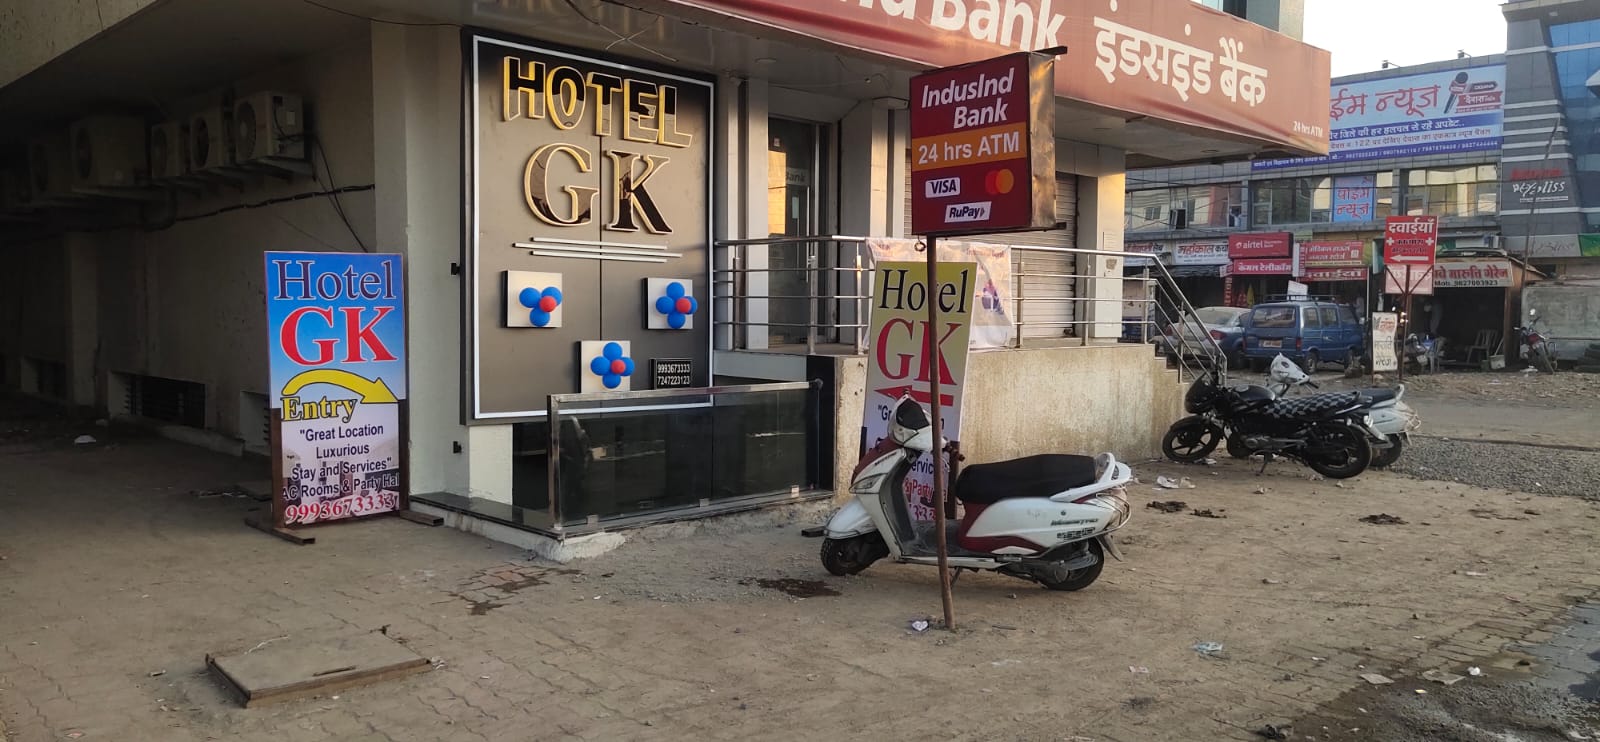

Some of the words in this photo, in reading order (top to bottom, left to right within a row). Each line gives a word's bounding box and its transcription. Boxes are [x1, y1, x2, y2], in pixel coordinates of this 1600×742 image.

[1094, 0, 1214, 102] इंडसइंड
[1219, 36, 1268, 108] बैंक
[922, 67, 1015, 108] IndusInd
[503, 56, 693, 148] HOTEL
[954, 98, 1008, 129] Bank
[1330, 88, 1368, 121] ईम
[1375, 84, 1442, 118] न्यूज
[1293, 121, 1301, 133] 24
[1302, 124, 1310, 135] hrs
[1311, 126, 1323, 138] ATM
[1371, 128, 1382, 137] हर
[1411, 122, 1420, 131] से
[918, 143, 938, 165] 24
[944, 141, 972, 161] hrs
[977, 131, 1019, 157] ATM
[524, 142, 672, 234] GK
[931, 179, 957, 195] VISA
[949, 206, 980, 219] RuPay
[1335, 202, 1369, 219] न्यूज
[1242, 239, 1263, 248] airtel
[273, 259, 396, 301] Hotel
[878, 268, 969, 313] Hoel
[280, 306, 398, 366] GK
[876, 317, 962, 387] GK
[657, 364, 691, 373] 9993673333
[657, 375, 690, 385] 7247223123
[281, 396, 357, 424] Entry
[299, 427, 336, 442] "Great
[338, 425, 384, 441] Location
[316, 444, 370, 459] Luxurious
[291, 463, 317, 482] Stay
[319, 462, 339, 478] and
[342, 457, 392, 475] Services"
[283, 487, 297, 501] AC
[301, 483, 339, 498] Rooms
[343, 480, 350, 493] &
[353, 477, 381, 495] Party
[285, 492, 398, 525] 9993673333
